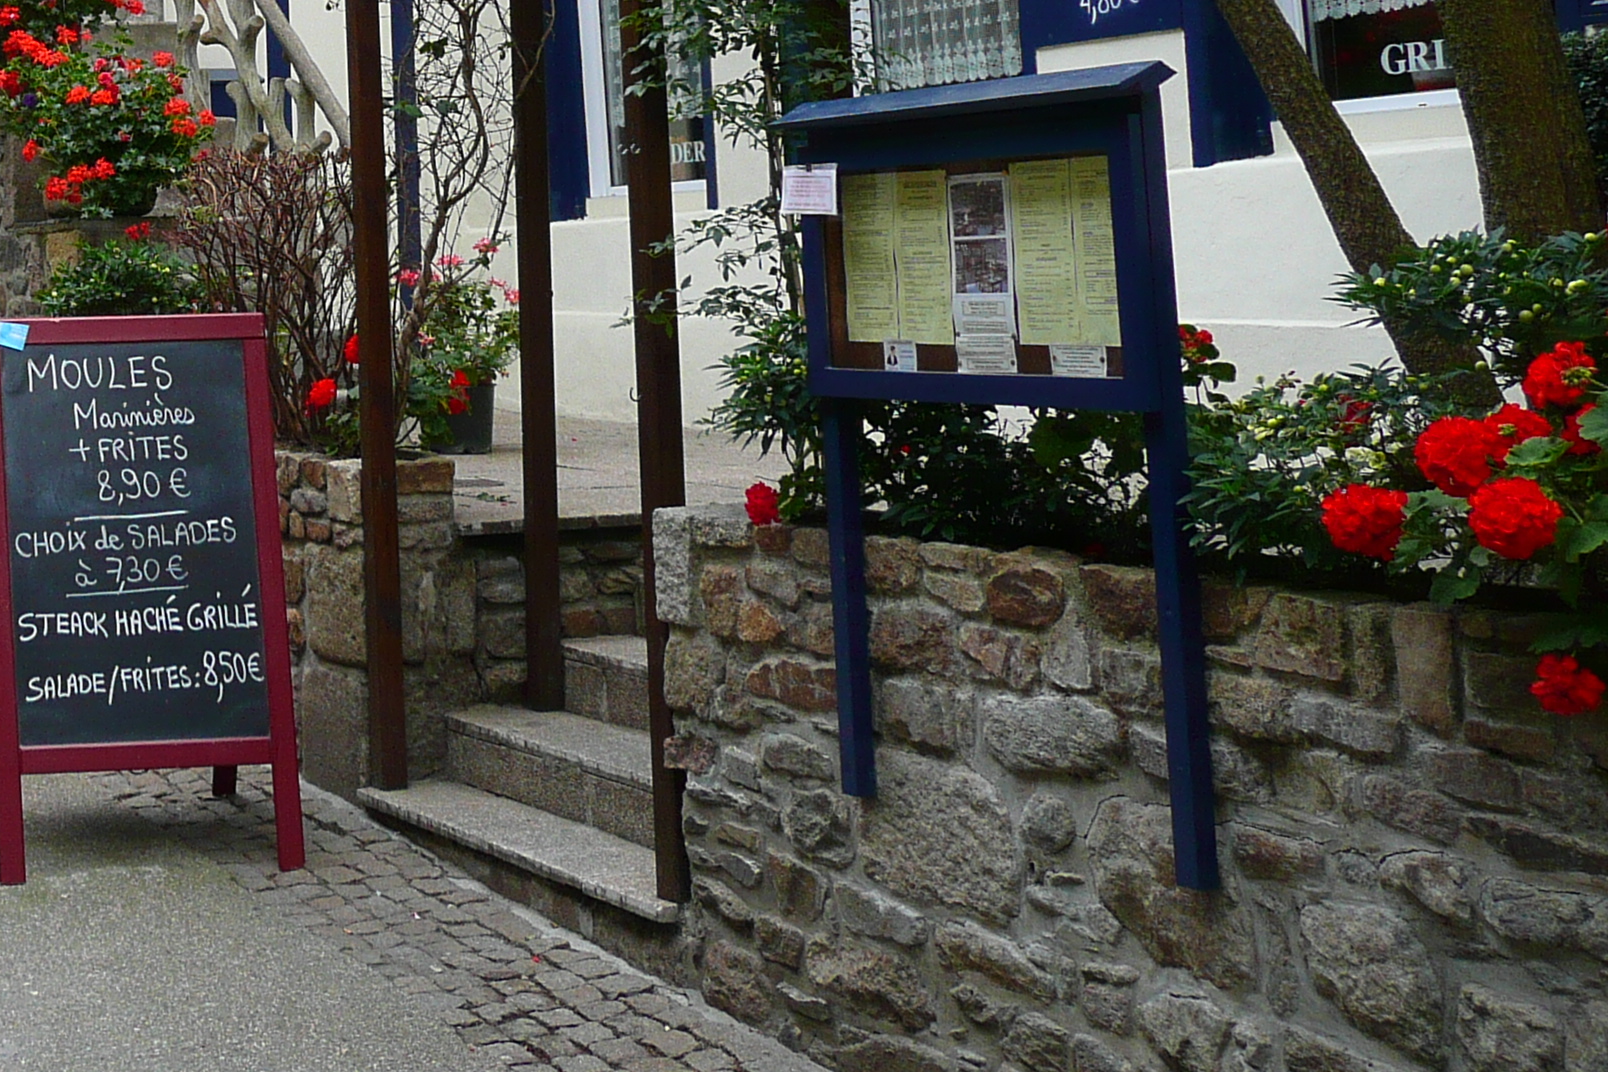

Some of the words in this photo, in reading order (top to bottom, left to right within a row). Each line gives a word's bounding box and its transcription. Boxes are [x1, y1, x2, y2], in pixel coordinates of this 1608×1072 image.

[27, 354, 173, 392] MOULES
[74, 393, 196, 430] Marinières
[15, 521, 87, 558] CHOIX
[95, 525, 124, 550] de
[131, 516, 237, 550] SALADES
[75, 559, 97, 587] à
[17, 612, 109, 641] STEACK
[115, 594, 184, 637] HACHÉ
[186, 583, 259, 631] GRILLÉ
